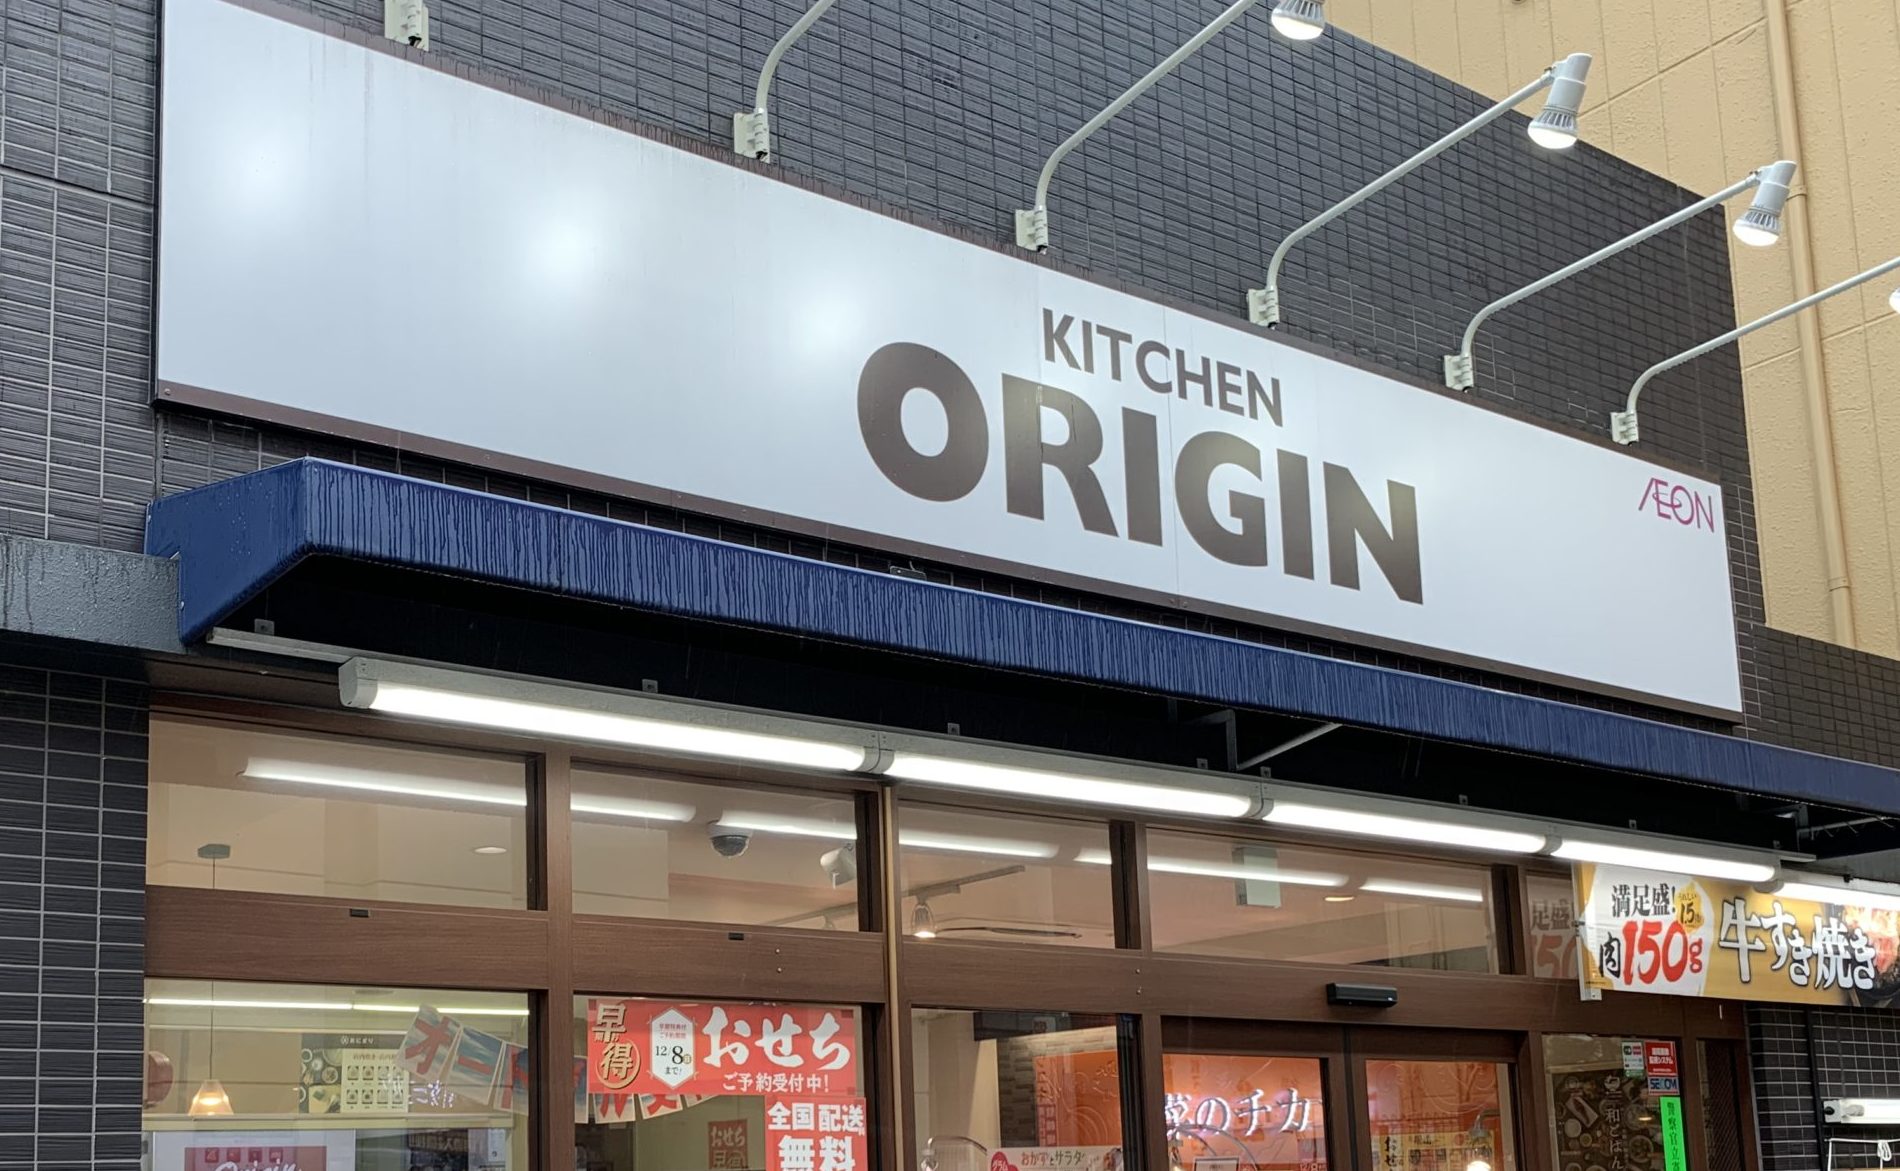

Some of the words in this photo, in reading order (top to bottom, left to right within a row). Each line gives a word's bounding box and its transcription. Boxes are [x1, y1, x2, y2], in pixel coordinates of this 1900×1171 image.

[1042, 308, 1283, 427] KITCHEN
[857, 341, 1424, 605] ORIGIN
[1611, 882, 1676, 919] 満足盛!
[1718, 895, 1876, 990] 牛すき焼き
[702, 1006, 852, 1071] おせち
[722, 1071, 830, 1093] ご予約受付中!
[767, 1101, 864, 1133] 全国配送
